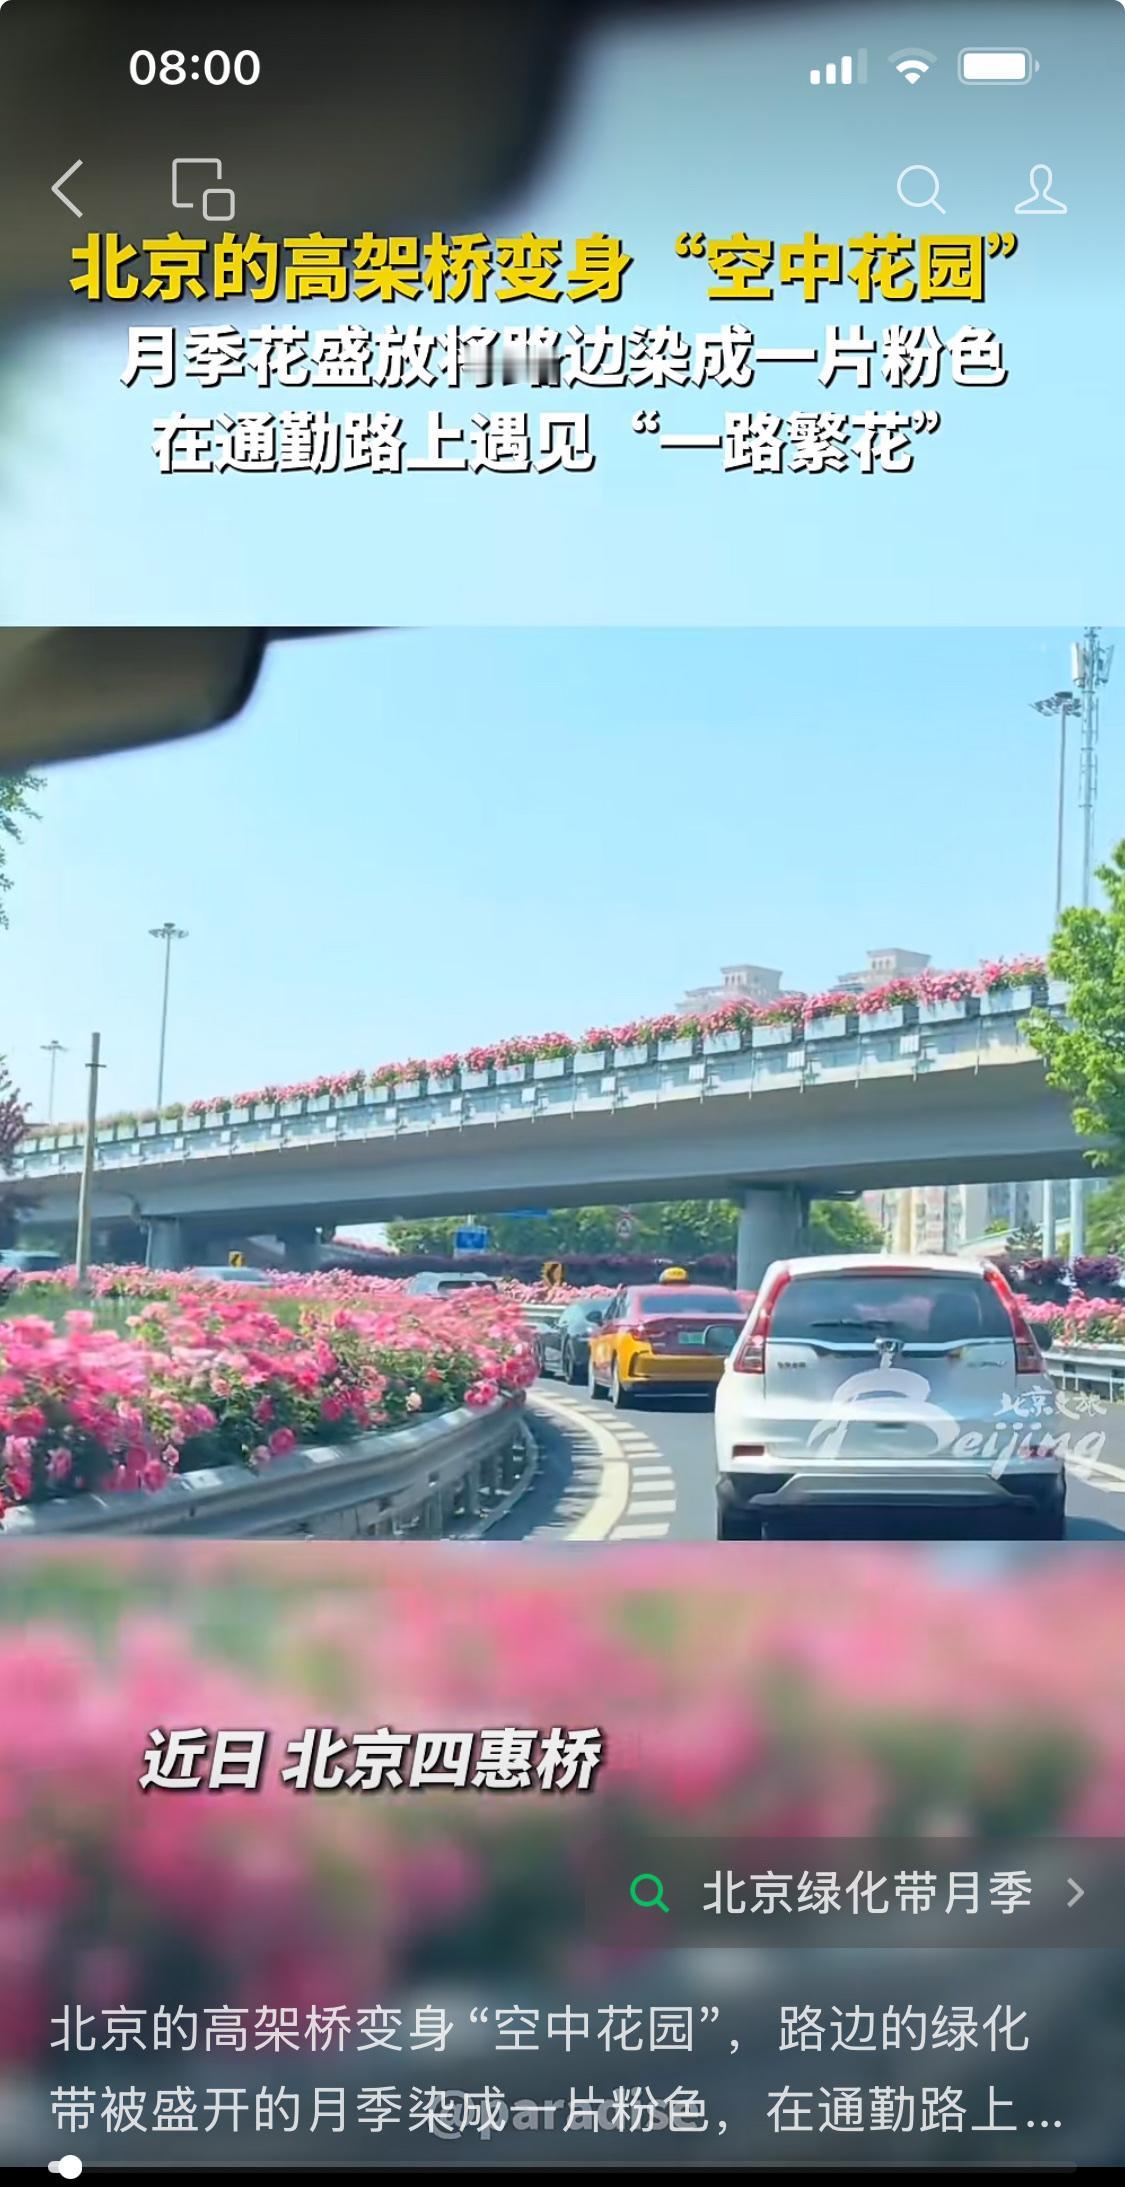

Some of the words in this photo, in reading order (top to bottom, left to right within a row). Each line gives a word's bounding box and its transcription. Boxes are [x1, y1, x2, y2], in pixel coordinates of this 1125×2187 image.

[129, 51, 261, 85] 08:00
[702, 1869, 1033, 1915] 北京绿化带月季
